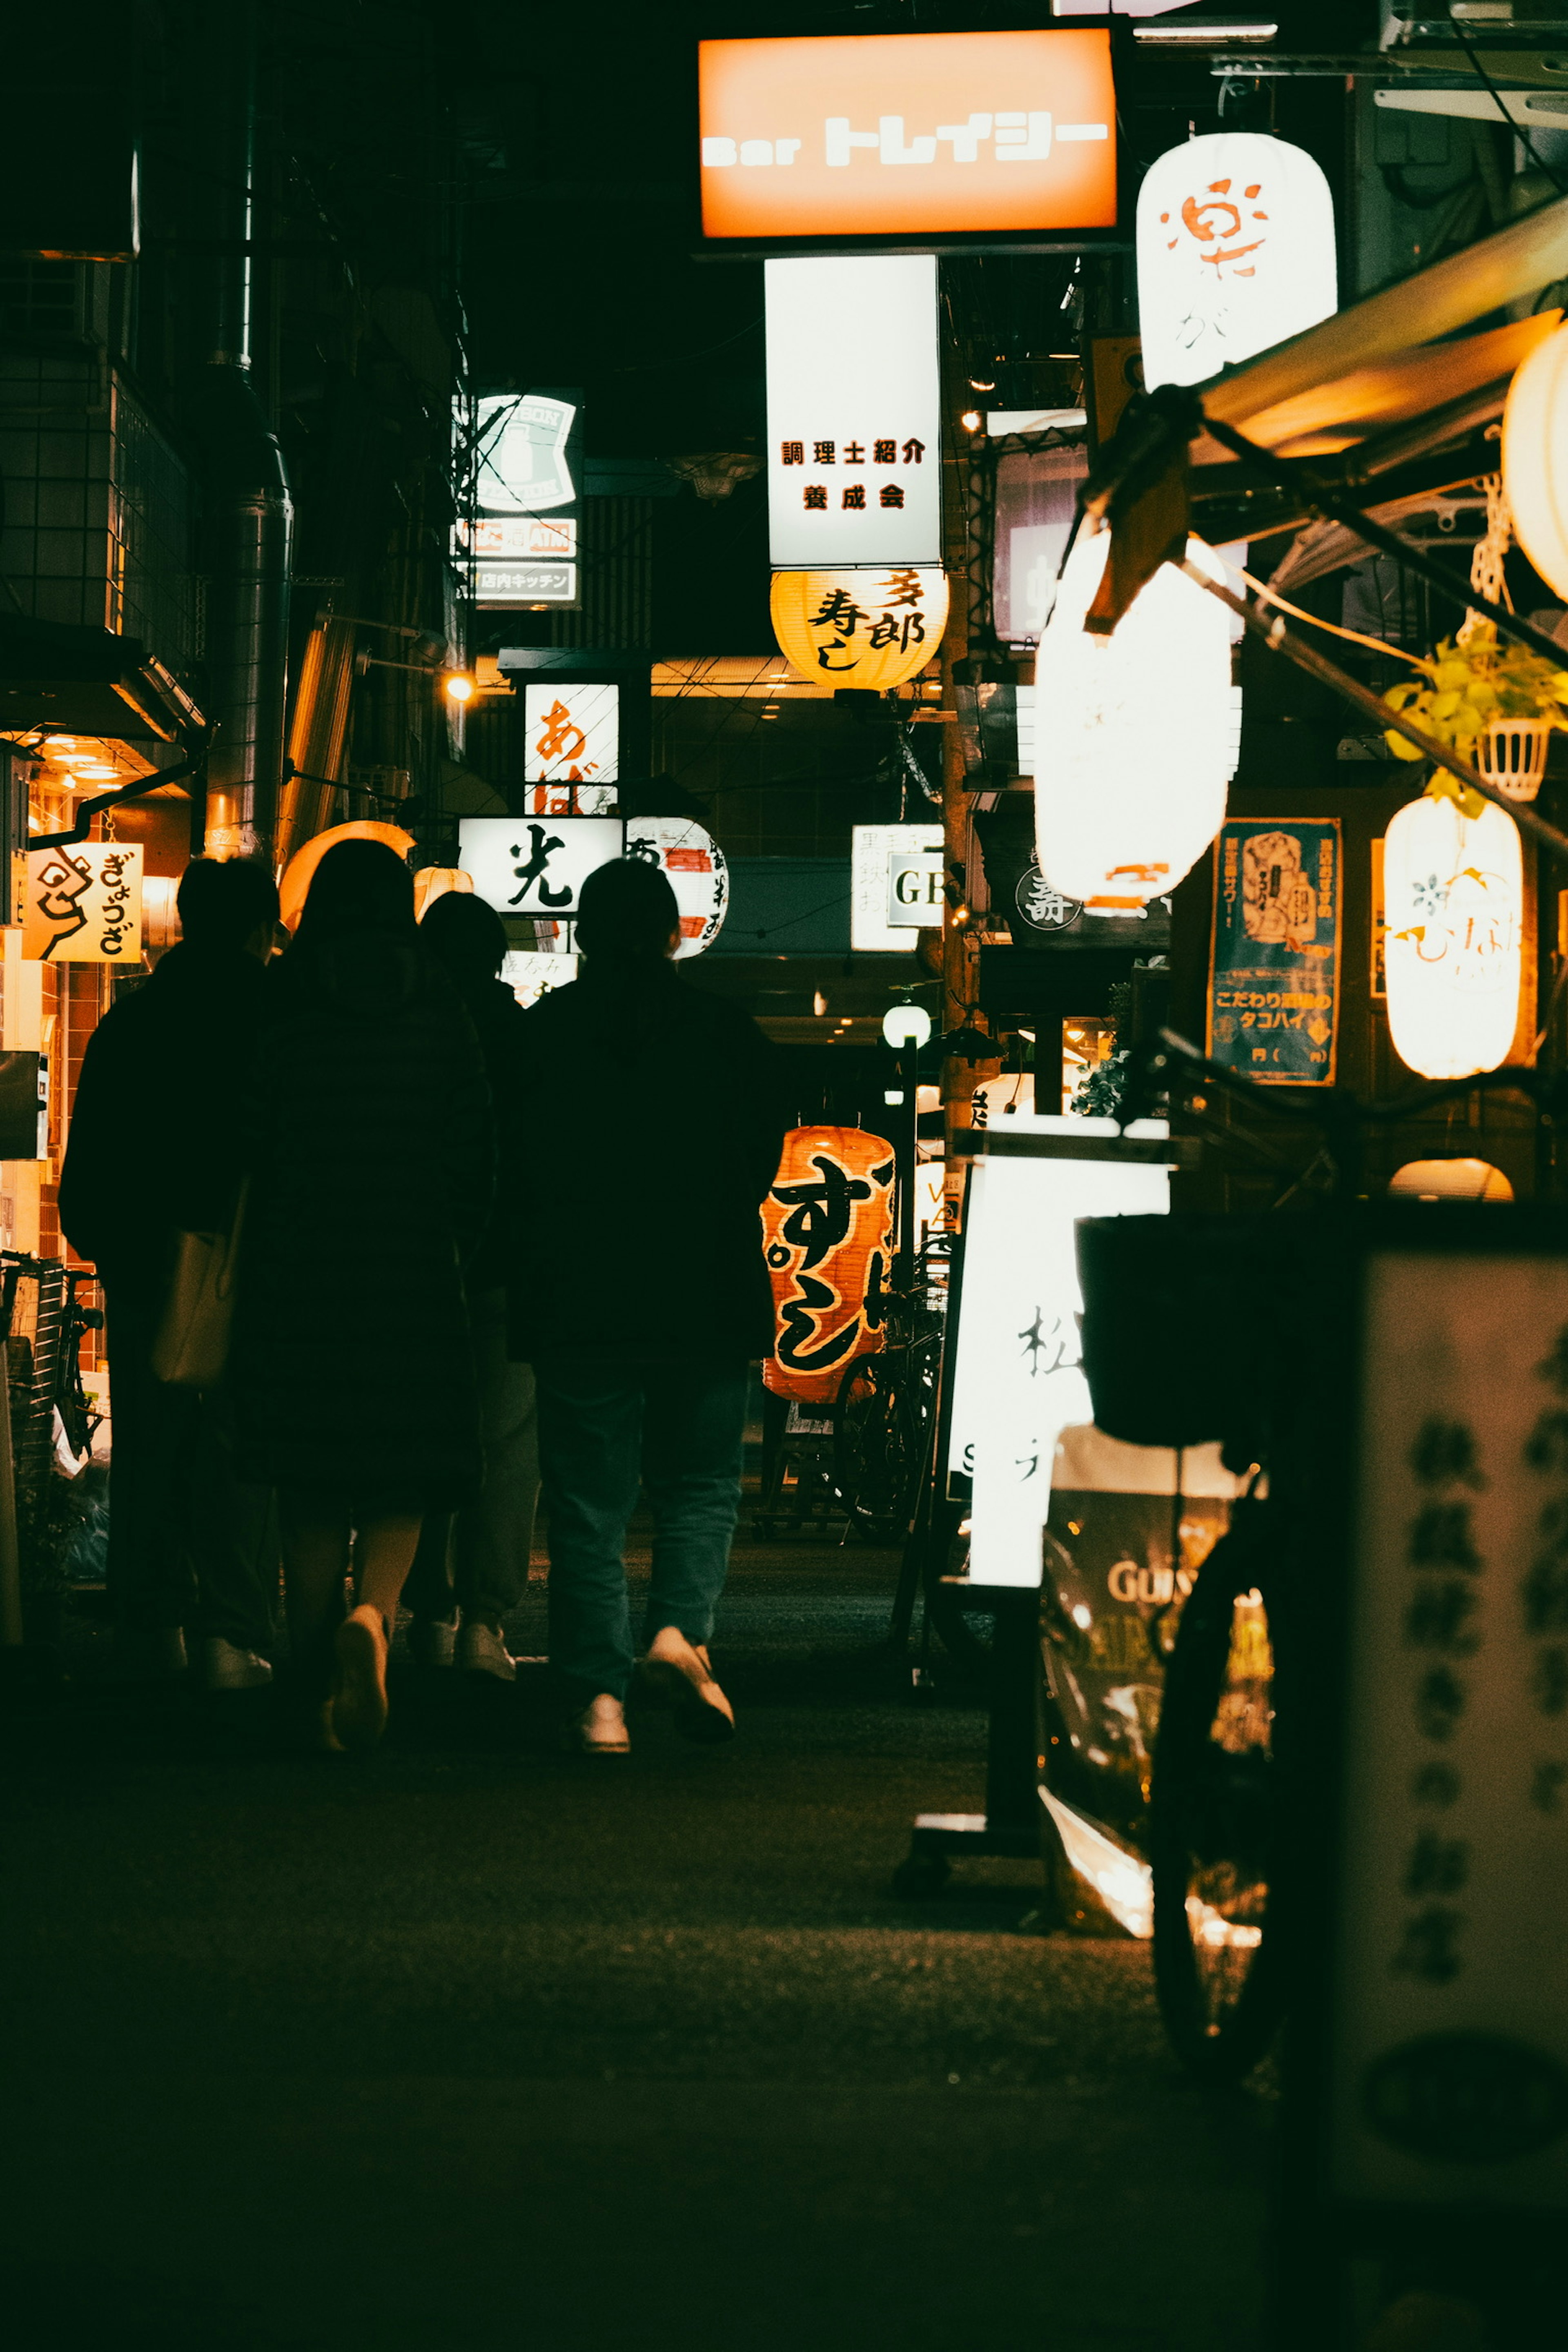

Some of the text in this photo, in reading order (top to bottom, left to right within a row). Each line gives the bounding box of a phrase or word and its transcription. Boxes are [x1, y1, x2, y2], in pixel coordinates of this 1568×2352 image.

[702, 137, 802, 167] Bar
[781, 438, 926, 466] 調理士紹介
[803, 483, 905, 510] 養成会
[530, 528, 569, 548] ATM
[481, 572, 567, 589] 店内キッチン
[507, 824, 572, 907] 光
[100, 850, 135, 955] ぎょうざ
[1239, 1011, 1306, 1029] タコハイ
